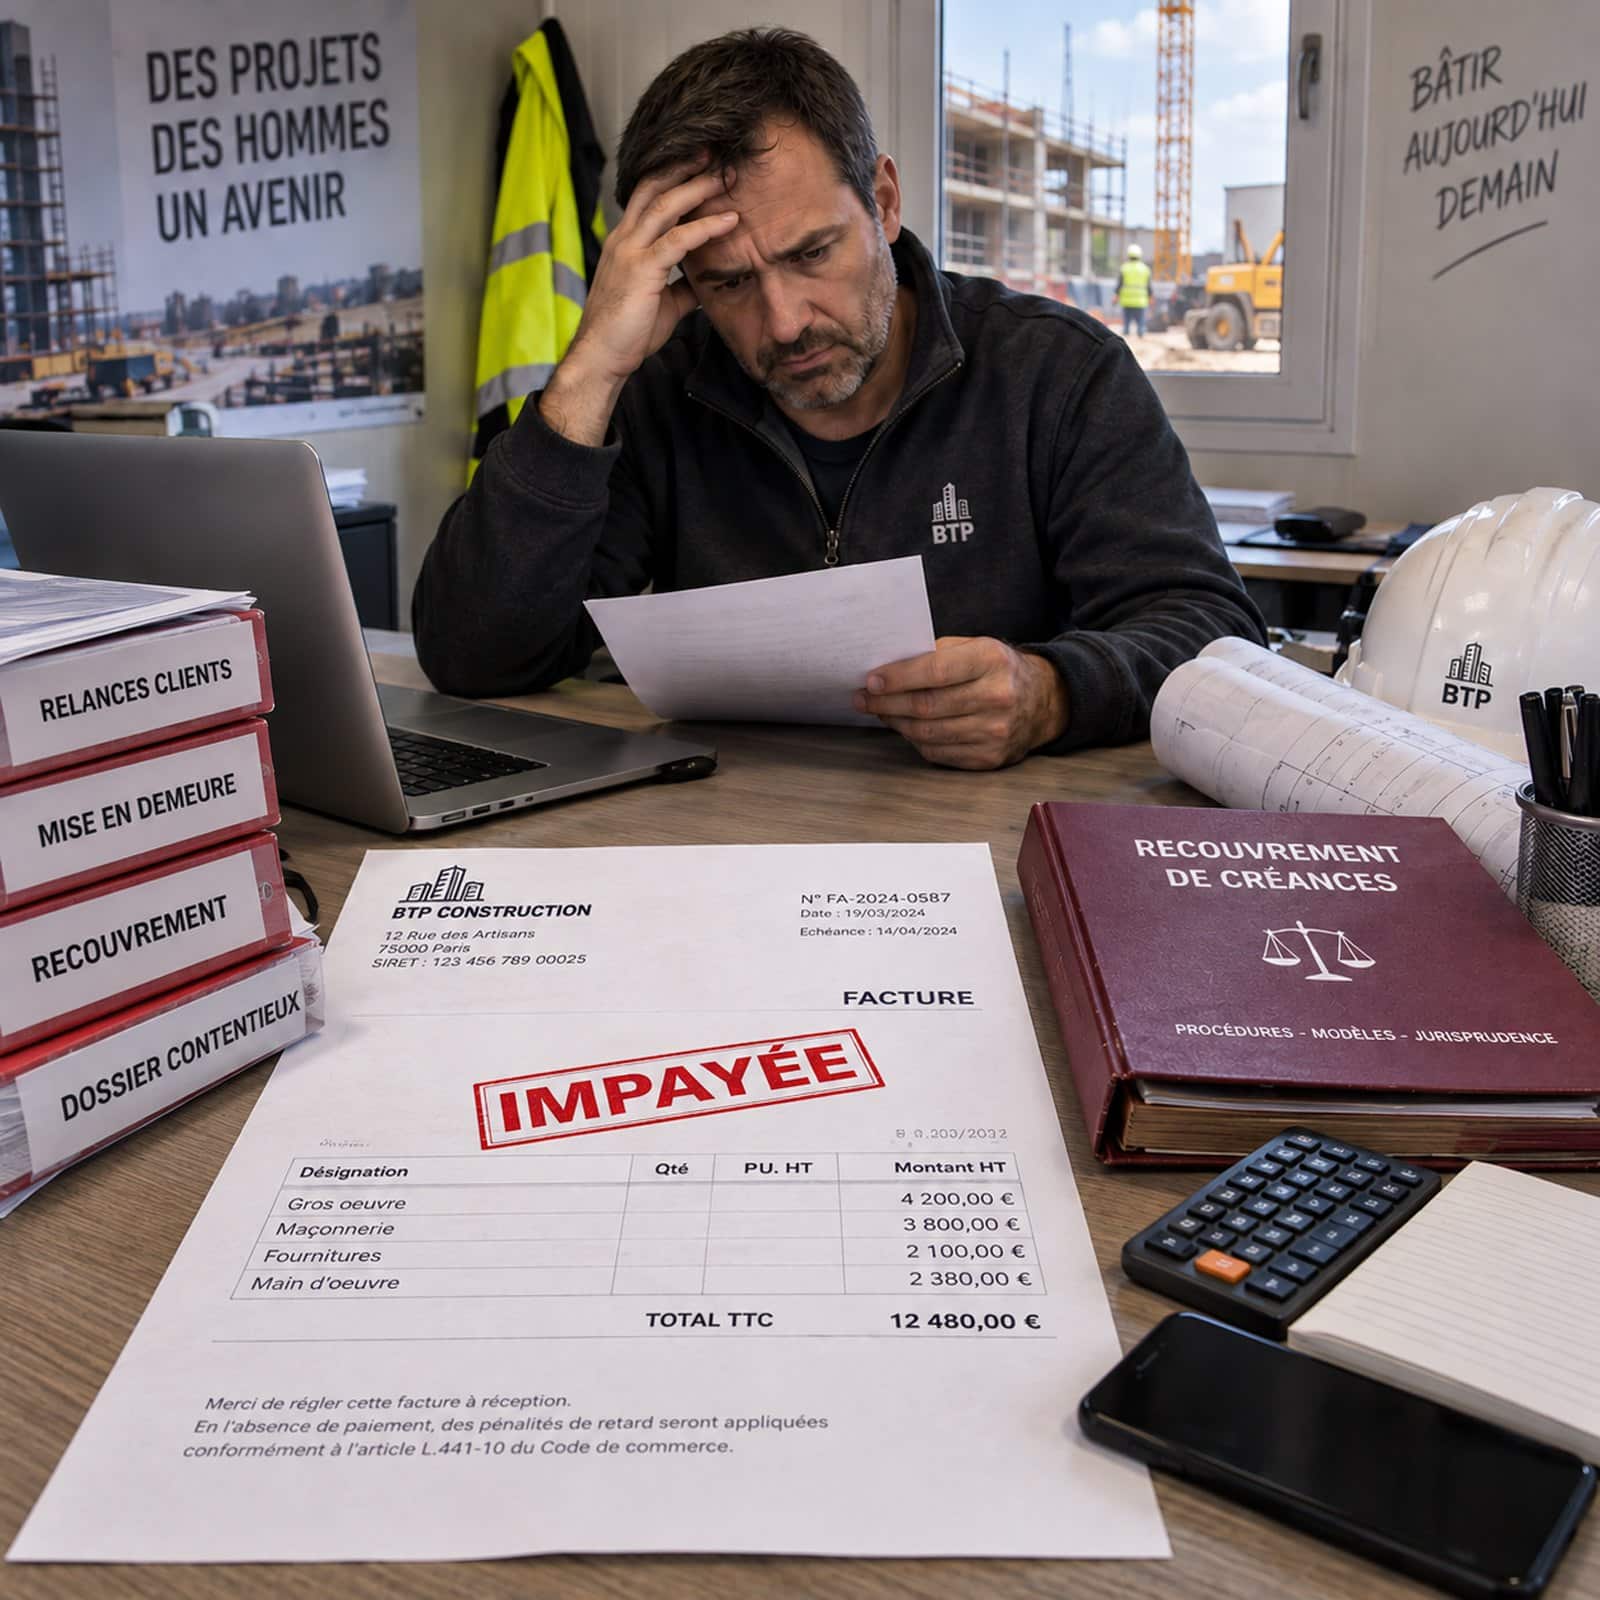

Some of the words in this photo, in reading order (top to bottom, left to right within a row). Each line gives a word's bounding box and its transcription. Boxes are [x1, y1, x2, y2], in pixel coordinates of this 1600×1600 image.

[147, 45, 218, 103] DES
[231, 32, 381, 95] PROJETS
[1410, 46, 1502, 112] BÂTIR
[152, 117, 223, 174] DES
[235, 99, 390, 164] HOMMES
[1404, 81, 1586, 175] AUJOURD'HUI
[1436, 150, 1558, 230] DEMAIN
[157, 189, 208, 243] UN
[222, 172, 346, 234] AVENIR
[932, 521, 974, 544] BTP
[40, 676, 150, 722] RELANCES
[155, 659, 233, 694] CLIENTS
[1442, 683, 1491, 709] BTP
[38, 811, 97, 848] MISE
[102, 802, 133, 830] EN
[137, 773, 237, 820] DEMEURE
[1134, 839, 1401, 864] RECOUVREMENT
[1166, 869, 1212, 887] DE
[1221, 866, 1398, 892] CRÉANCES
[801, 894, 821, 904] N°
[827, 893, 951, 903] FA-2024-0587
[392, 907, 432, 919] BTP
[436, 904, 592, 918] CONSTRUCTION
[800, 909, 832, 918] Date
[845, 908, 926, 918] 19/03/2024
[31, 895, 228, 983] RECOUVREMENT
[385, 931, 403, 940] 12
[407, 931, 436, 940] Rue
[441, 931, 468, 940] des
[473, 929, 535, 939] Artisans
[800, 926, 865, 936] Echéance
[877, 926, 958, 936] 14/04/2024
[379, 944, 428, 954] 75000
[432, 943, 471, 953] Paris
[372, 958, 419, 968] SIRET
[433, 957, 461, 966] 123
[466, 956, 496, 966] 456
[502, 956, 531, 965] 789
[536, 954, 587, 964] 00025
[843, 991, 974, 1005] FACTURE
[1175, 1022, 1293, 1039] PROCÉDURES
[1311, 1026, 1396, 1041] MODÈLES
[1414, 1030, 1557, 1045] JURISPRUDENCE
[61, 1056, 162, 1121] DOSSIER
[167, 991, 300, 1072] CONTENTIEUX
[500, 1043, 858, 1132] IMPAYÉE
[300, 1165, 409, 1180] Désignation
[655, 1162, 689, 1175] Qté
[744, 1162, 778, 1175] PU.
[786, 1162, 813, 1174] HT
[895, 1162, 973, 1174] Montant
[980, 1162, 1006, 1173] HT
[287, 1197, 333, 1211] Gros
[339, 1198, 406, 1210] oeuvre
[901, 1193, 913, 1206] 4
[921, 1193, 993, 1207] 200,00
[1001, 1193, 1015, 1206] €
[275, 1222, 395, 1239] Maçonnerie
[903, 1218, 916, 1231] 3
[923, 1218, 999, 1233] 800,00
[1006, 1218, 1020, 1231] €
[264, 1249, 382, 1263] Fournitures
[907, 1245, 919, 1258] 2
[928, 1244, 1004, 1260] 100,00
[1011, 1245, 1026, 1258] €
[251, 1277, 303, 1291] Main
[310, 1276, 400, 1291] d'oeuvre
[909, 1272, 923, 1286] 2
[930, 1272, 1009, 1288] 380,00
[1017, 1272, 1032, 1286] €
[646, 1312, 720, 1327] TOTAL
[728, 1312, 774, 1327] TTC
[890, 1313, 920, 1329] 12
[927, 1313, 1016, 1331] 480,00
[1024, 1314, 1041, 1329] €
[205, 1398, 257, 1410] Merci
[261, 1398, 284, 1409] de
[289, 1398, 343, 1413] régler
[347, 1397, 392, 1409] cette
[397, 1395, 460, 1409] facture
[465, 1395, 476, 1408] à
[481, 1394, 571, 1412] réception.
[194, 1420, 217, 1433] En
[223, 1419, 310, 1433] l'absence
[316, 1420, 339, 1432] de
[343, 1420, 435, 1435] paiement,
[441, 1418, 473, 1432] des
[479, 1416, 563, 1433] pénalités
[569, 1417, 592, 1430] de
[598, 1416, 653, 1429] retard
[659, 1416, 718, 1429] seront
[724, 1415, 828, 1431] appliquées
[183, 1444, 325, 1458] conformément
[330, 1443, 341, 1456] à
[347, 1443, 415, 1456] l'article
[421, 1441, 504, 1455] L.441-10
[511, 1441, 533, 1454] du
[541, 1441, 590, 1454] Code
[596, 1441, 619, 1453] de
[625, 1441, 734, 1453] commerce.
